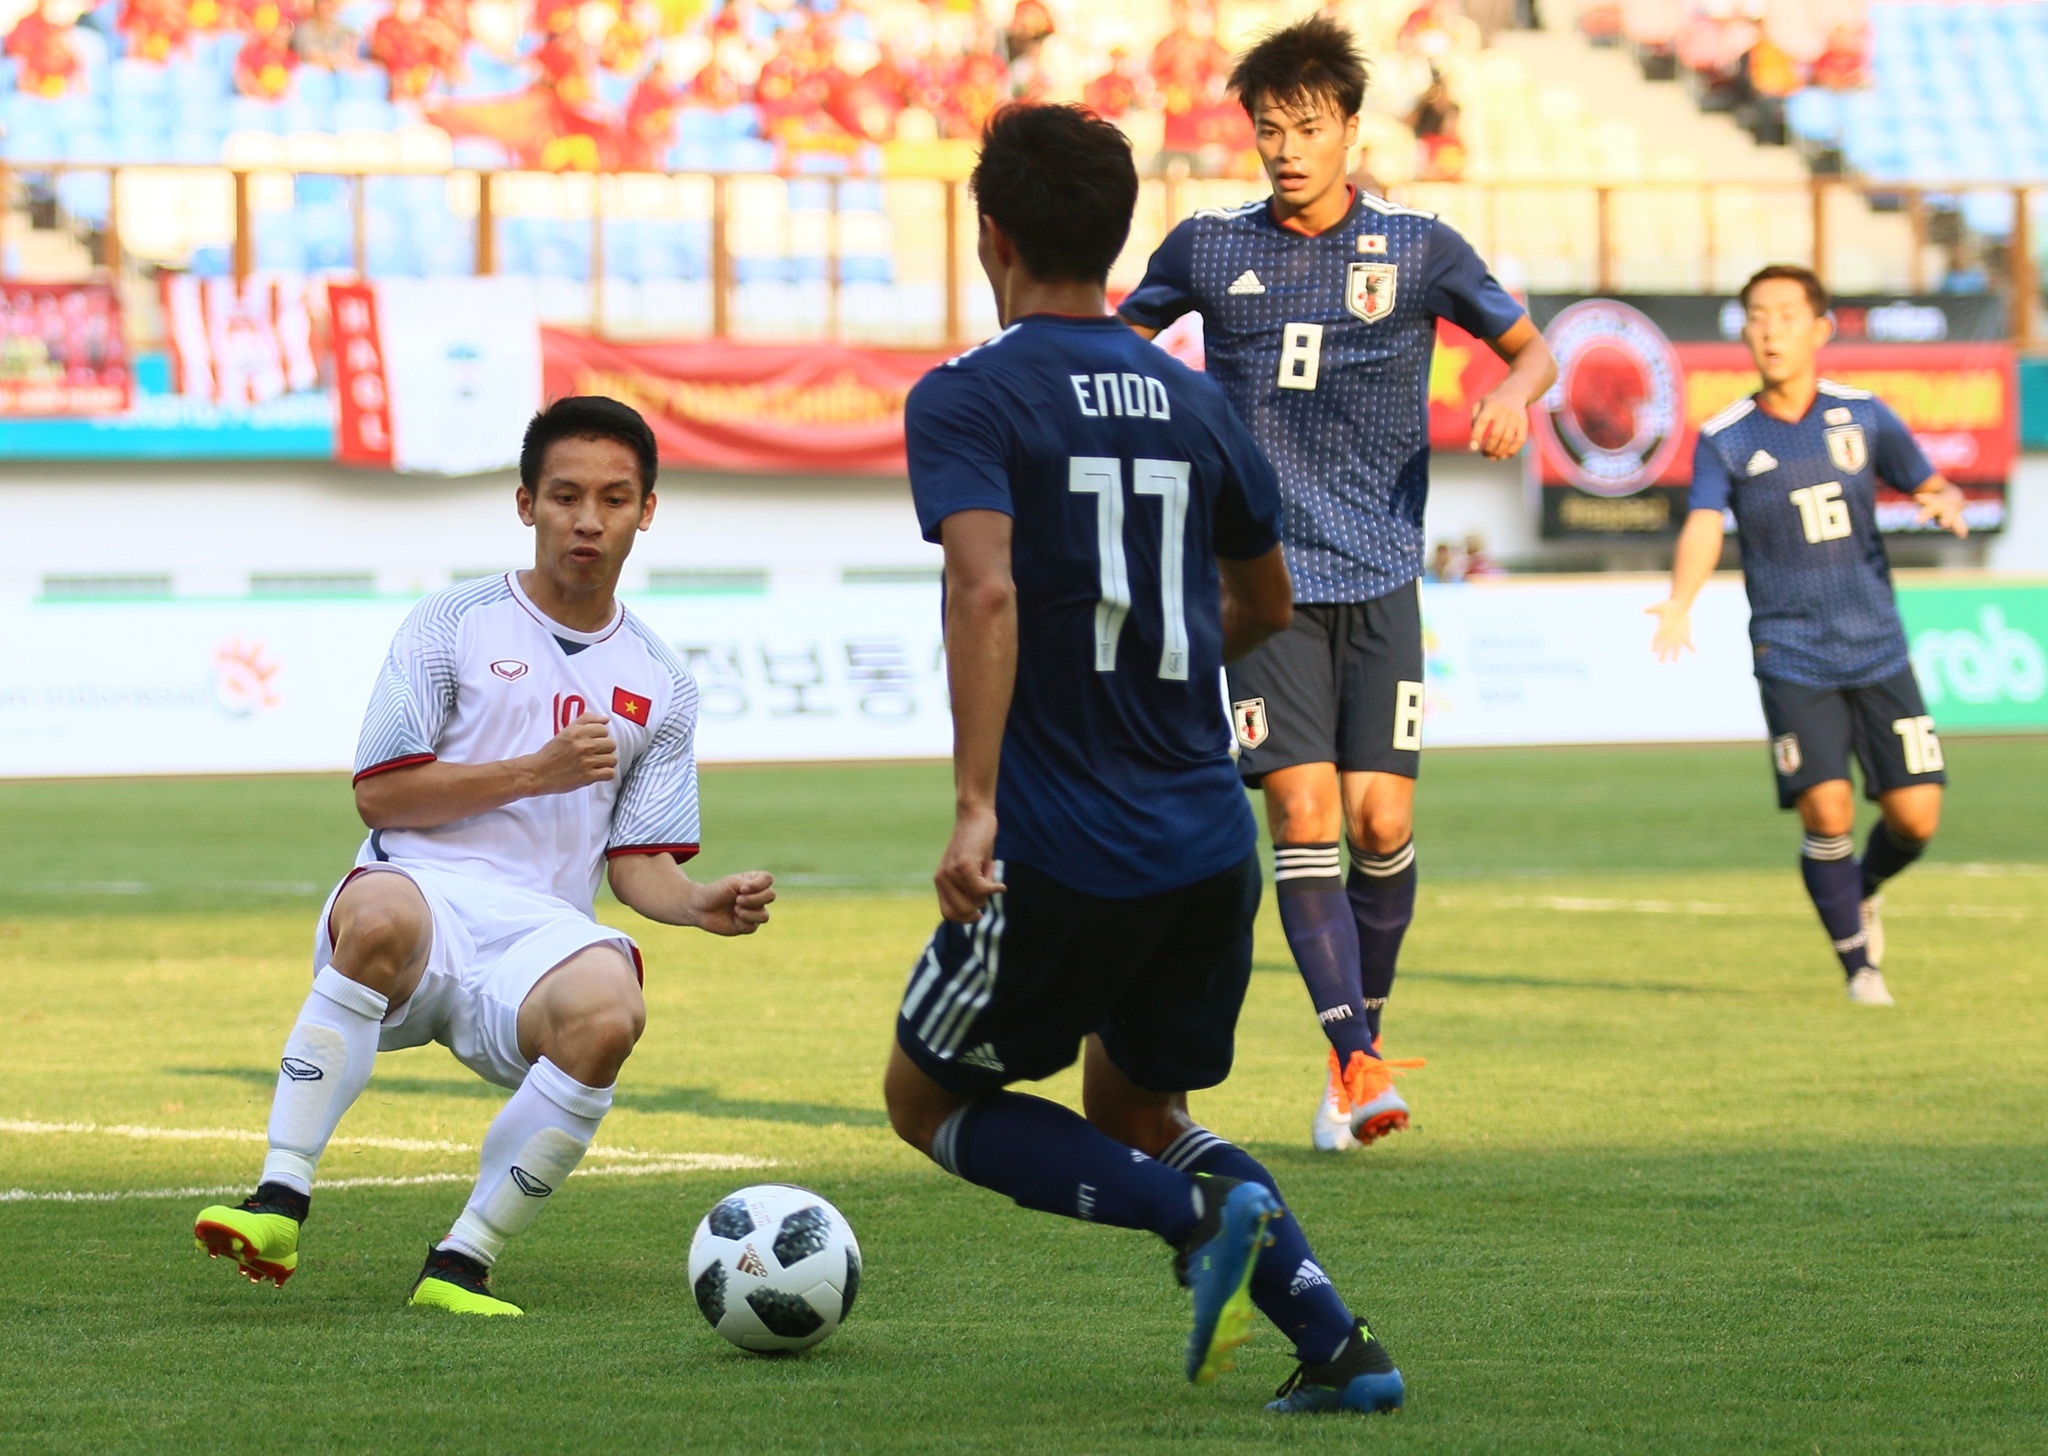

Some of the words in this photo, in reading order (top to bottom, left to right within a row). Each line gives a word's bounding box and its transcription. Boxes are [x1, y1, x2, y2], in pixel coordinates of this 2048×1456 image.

[1278, 322, 1324, 391] 8
[1788, 480, 1853, 545] 16
[674, 638, 950, 723] 정보통
[1392, 680, 1424, 752] 8
[1891, 714, 1945, 775] 16
